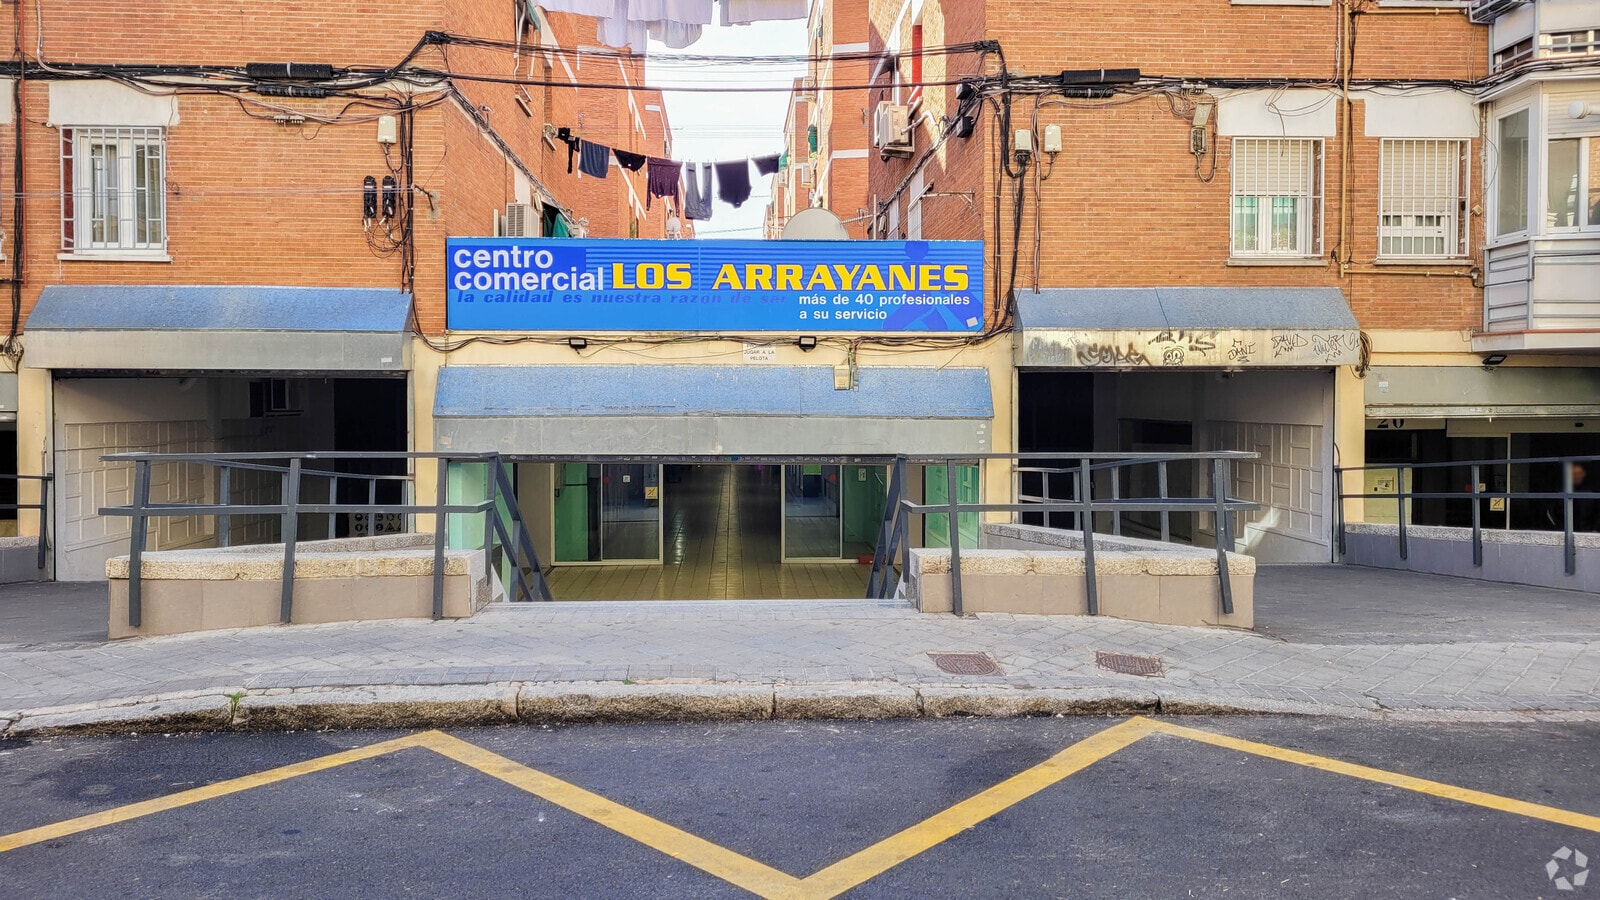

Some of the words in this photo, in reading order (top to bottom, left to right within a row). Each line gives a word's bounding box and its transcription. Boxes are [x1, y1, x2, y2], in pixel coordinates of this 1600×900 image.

[453, 245, 554, 269] centro
[453, 266, 604, 291] comercial
[612, 262, 693, 290] LOS
[711, 263, 969, 291] ARRAYANES
[457, 290, 475, 303] la
[484, 290, 554, 303] calidad
[562, 293, 583, 304] es
[591, 291, 661, 304] nuestra
[730, 292, 753, 304] de
[761, 294, 788, 304] ser
[799, 293, 827, 305] más
[832, 294, 850, 305] de
[855, 294, 874, 305] 40
[879, 293, 970, 307] profesionales
[799, 310, 808, 320] a
[813, 310, 829, 320] su
[835, 308, 888, 320] servicio
